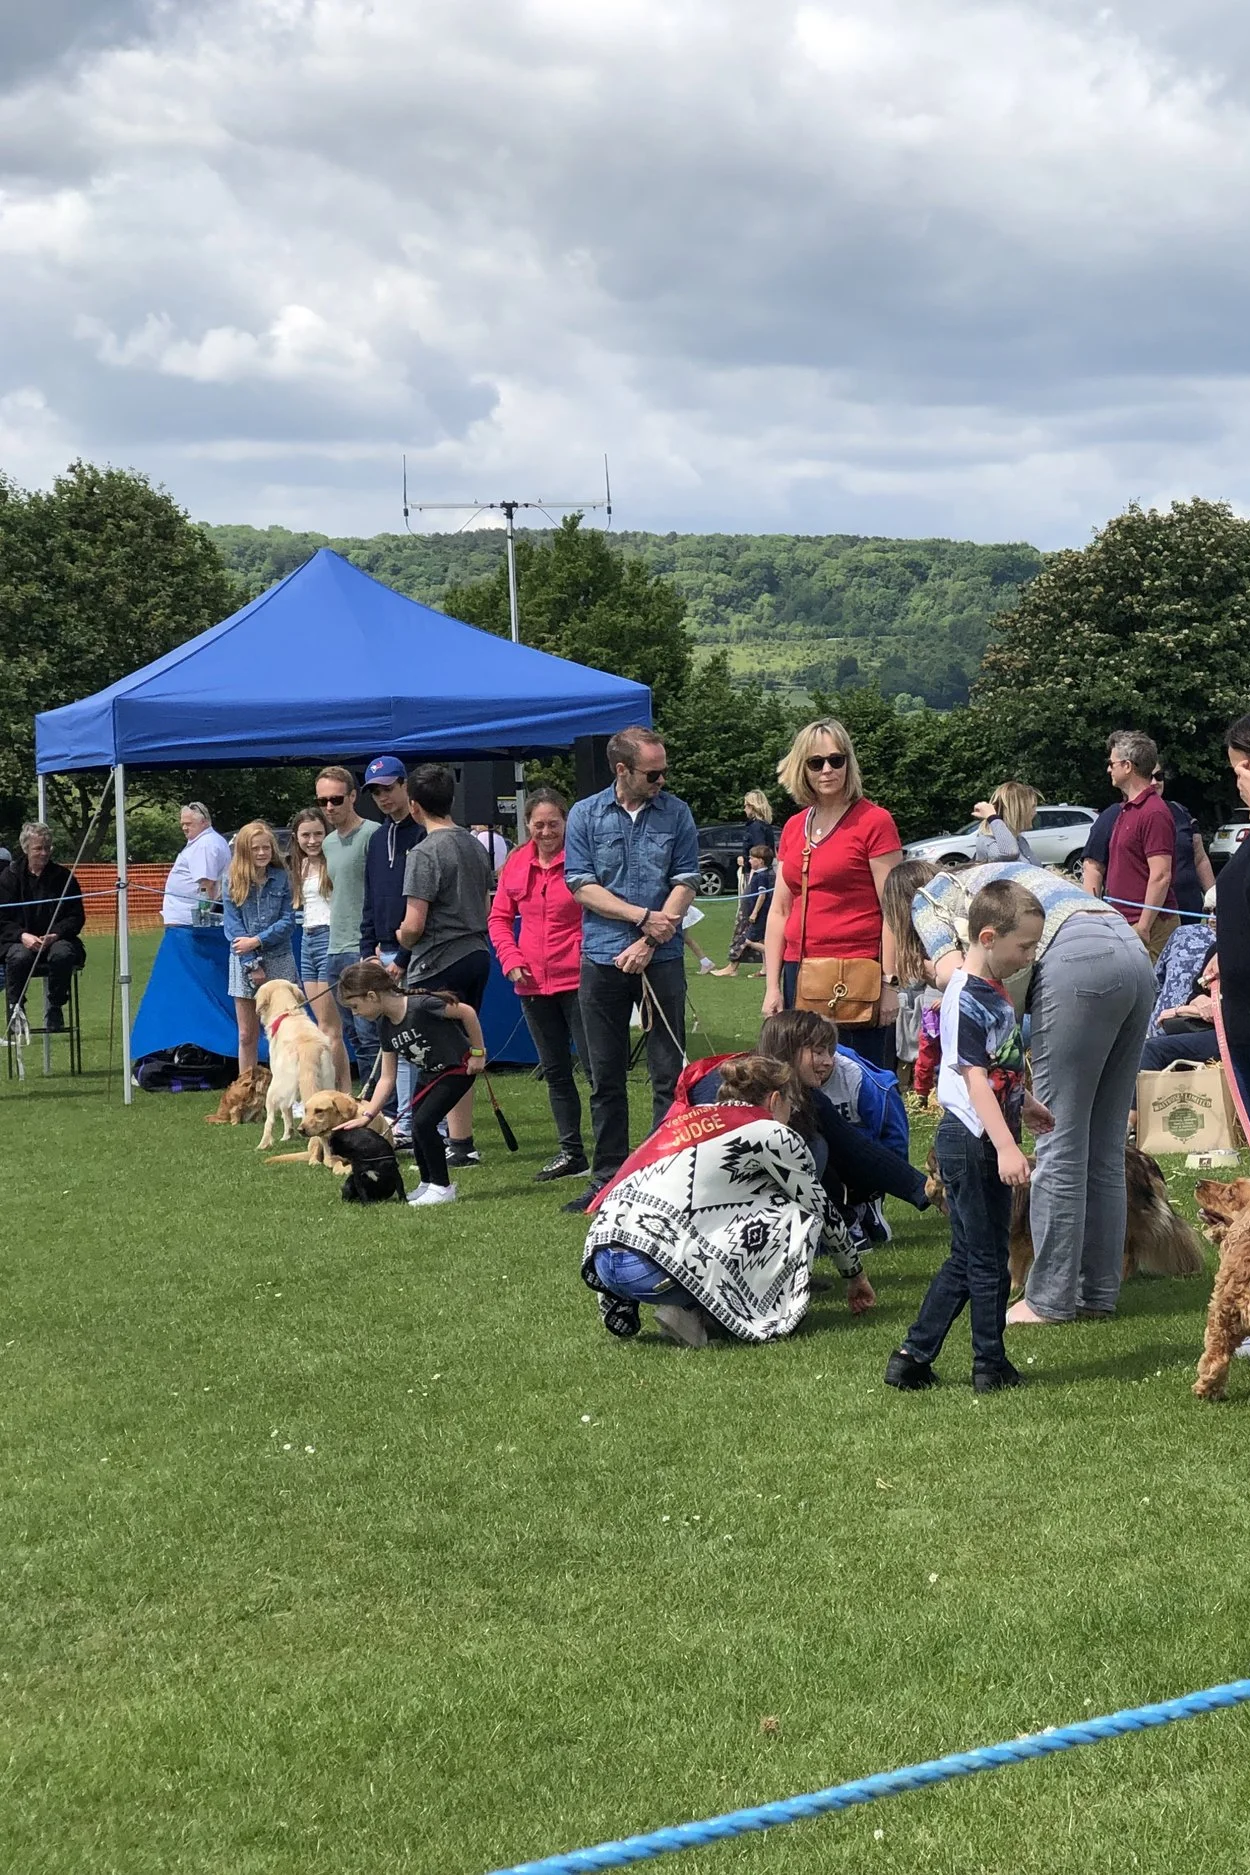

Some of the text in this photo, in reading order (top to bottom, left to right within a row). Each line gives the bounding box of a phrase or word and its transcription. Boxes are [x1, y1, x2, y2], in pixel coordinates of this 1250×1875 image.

[391, 1028, 422, 1049] GIRL
[1184, 1093, 1211, 1108] LIMITED
[671, 1113, 726, 1147] JUDGE
